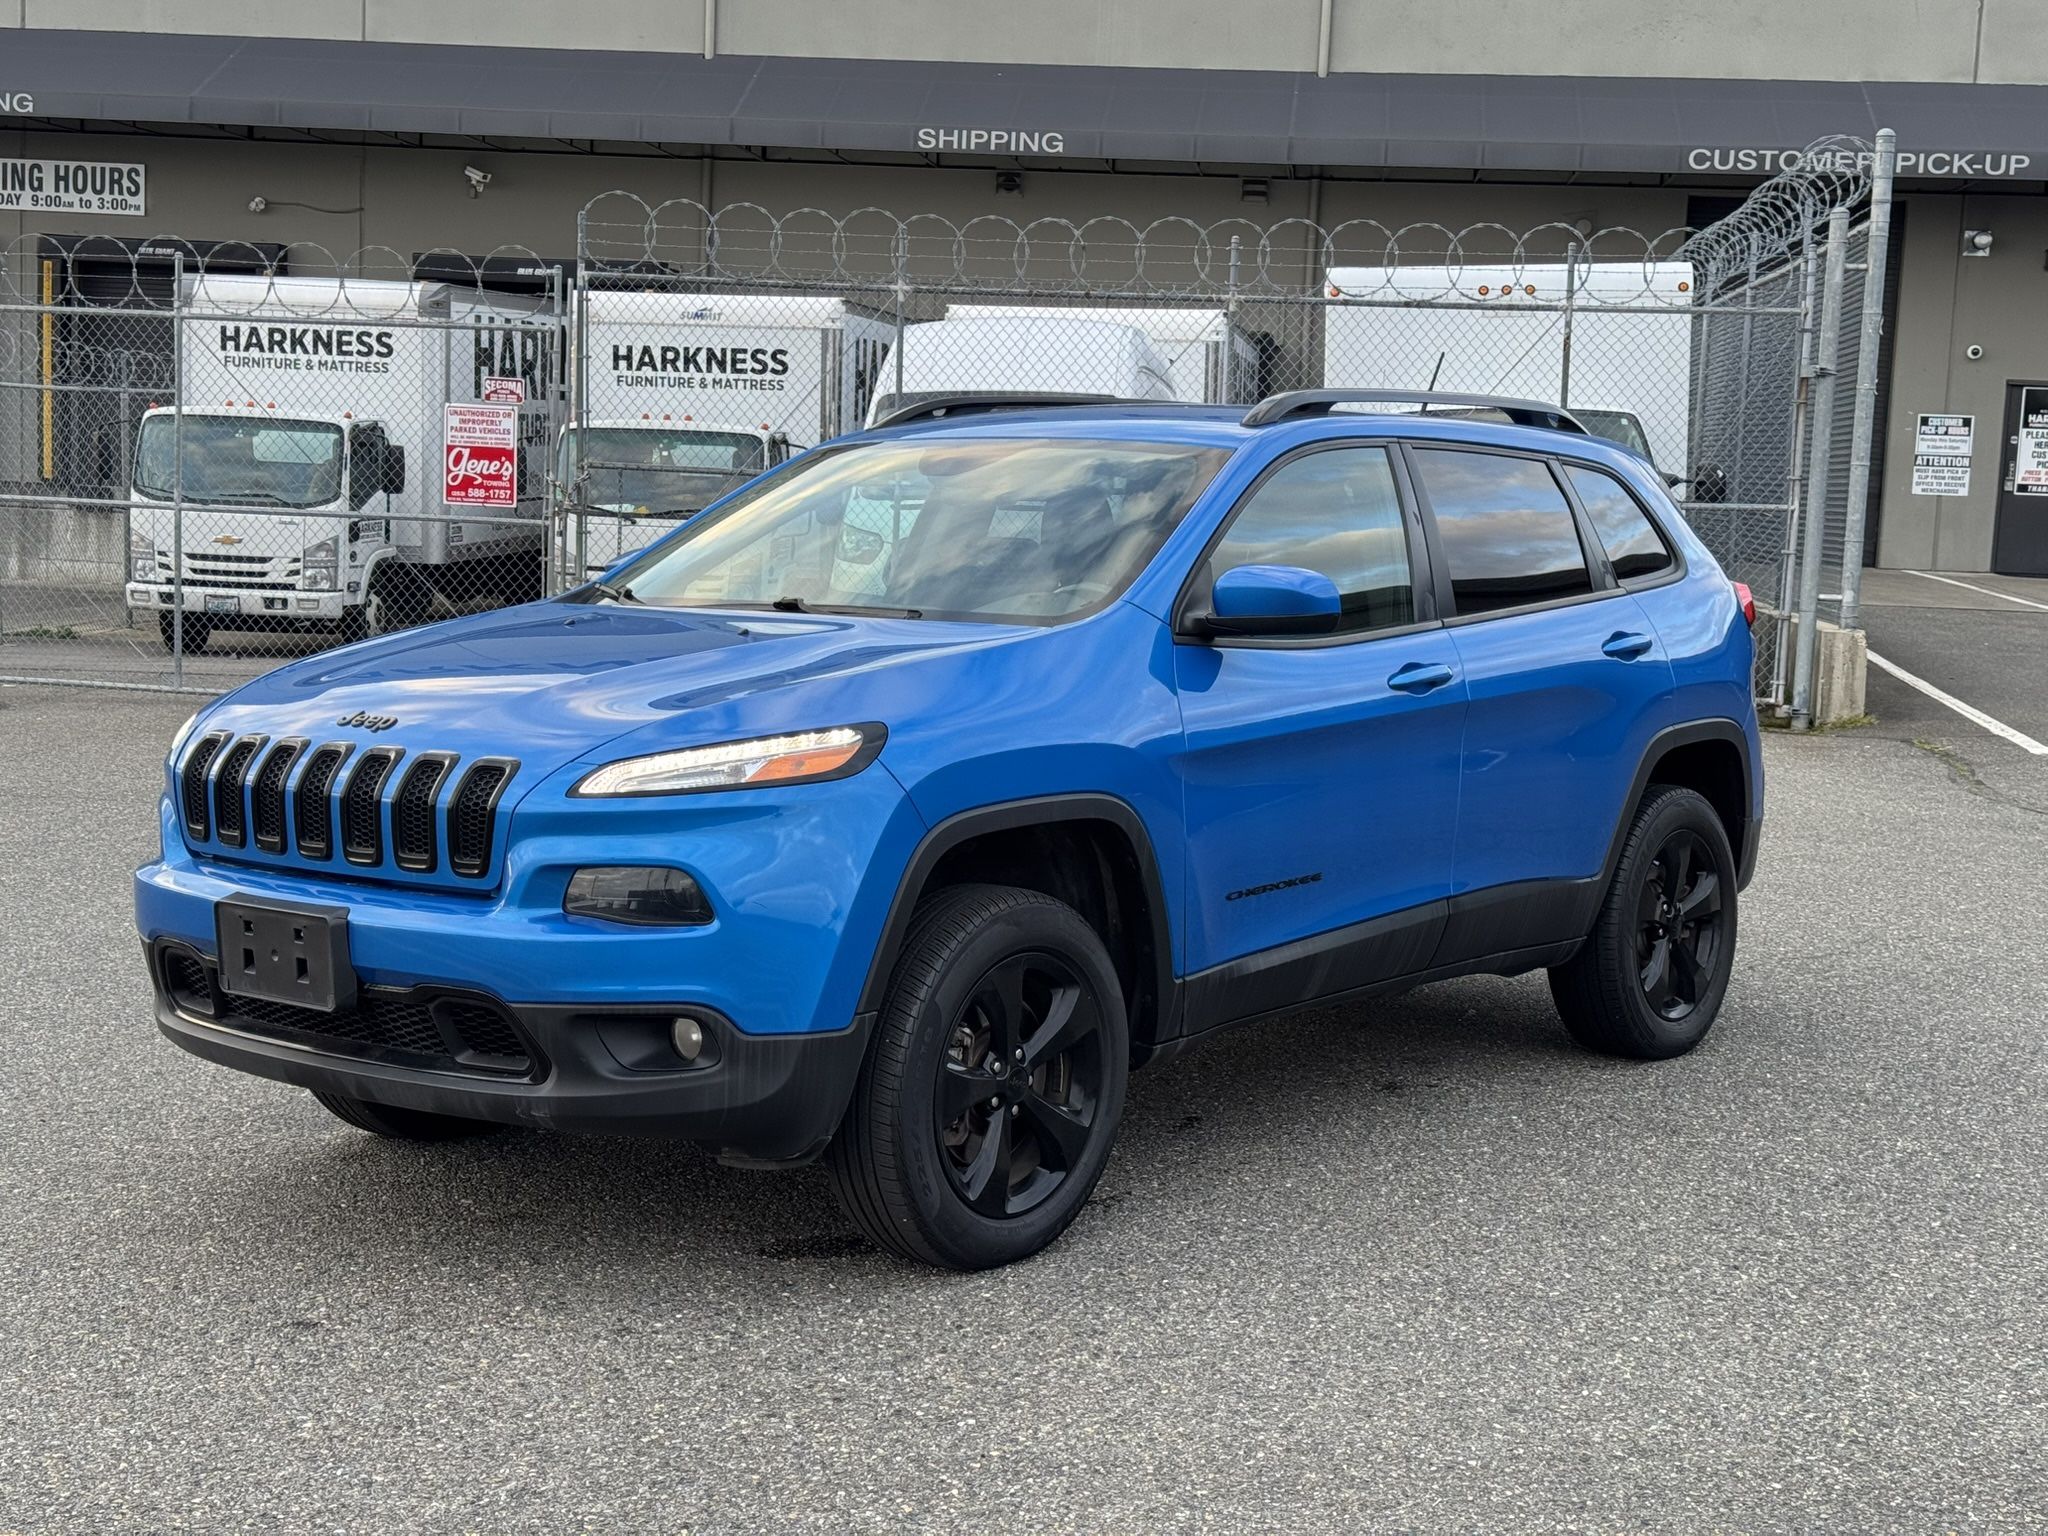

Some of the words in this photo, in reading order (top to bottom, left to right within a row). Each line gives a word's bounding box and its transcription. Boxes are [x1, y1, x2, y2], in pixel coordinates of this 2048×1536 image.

[917, 127, 1065, 154] SHIPPING
[1895, 152, 2031, 177] PICK-UP
[54, 164, 141, 198] HOURS
[31, 194, 75, 209] 9:00AM
[79, 197, 92, 209] to
[97, 197, 142, 212] 3:00PM
[679, 310, 723, 322] SUMMIT
[220, 325, 394, 359] HARKNESS
[224, 355, 301, 371] FURNITURE
[305, 358, 314, 371] &
[318, 359, 389, 374] MATTRESS
[612, 344, 789, 376] HARKNESS
[484, 379, 523, 398] SECOMA
[616, 375, 695, 389] FURNITURE
[699, 377, 708, 390] &
[712, 378, 785, 392] MATTRESS
[449, 409, 501, 419] UNAUTHORIZED
[458, 418, 502, 427] IMPROPERLY
[450, 426, 477, 434] PARKED
[479, 428, 511, 436] VEHICLES
[1915, 456, 1970, 467] ATTENTION
[467, 488, 511, 499] 588-1757
[336, 710, 399, 733] Jeep
[1225, 872, 1323, 901] CHEROKEE
